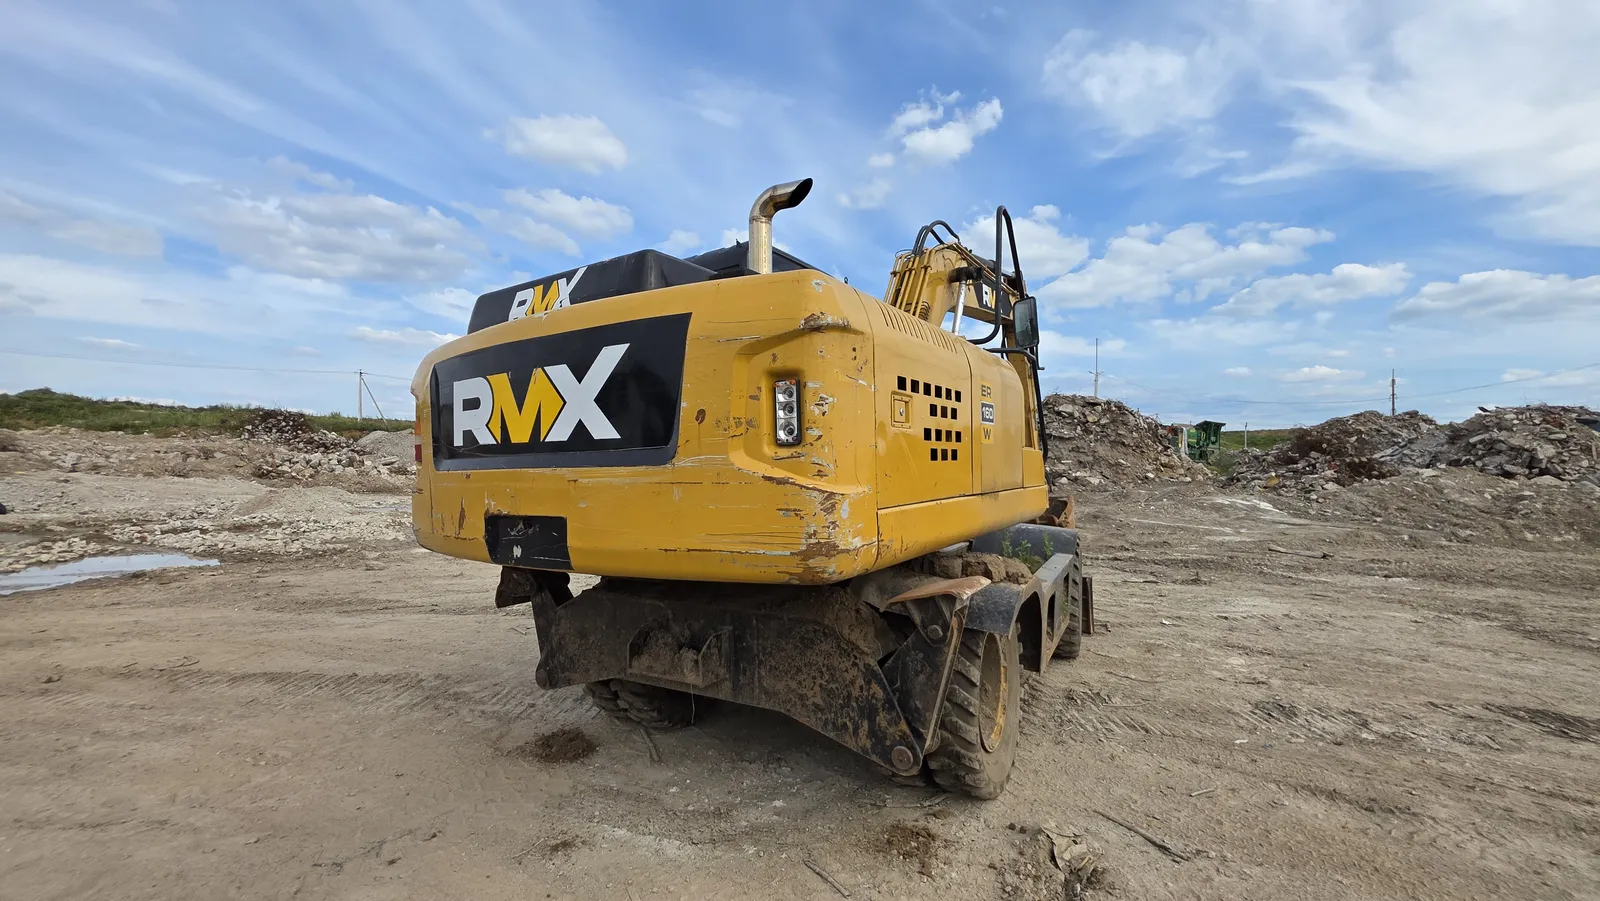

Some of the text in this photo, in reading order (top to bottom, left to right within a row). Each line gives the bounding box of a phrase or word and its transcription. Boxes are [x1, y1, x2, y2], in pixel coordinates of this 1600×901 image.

[508, 266, 588, 321] RMX
[453, 343, 631, 447] RMX
[981, 384, 992, 398] ER
[982, 406, 994, 420] 160
[983, 427, 991, 440] W
